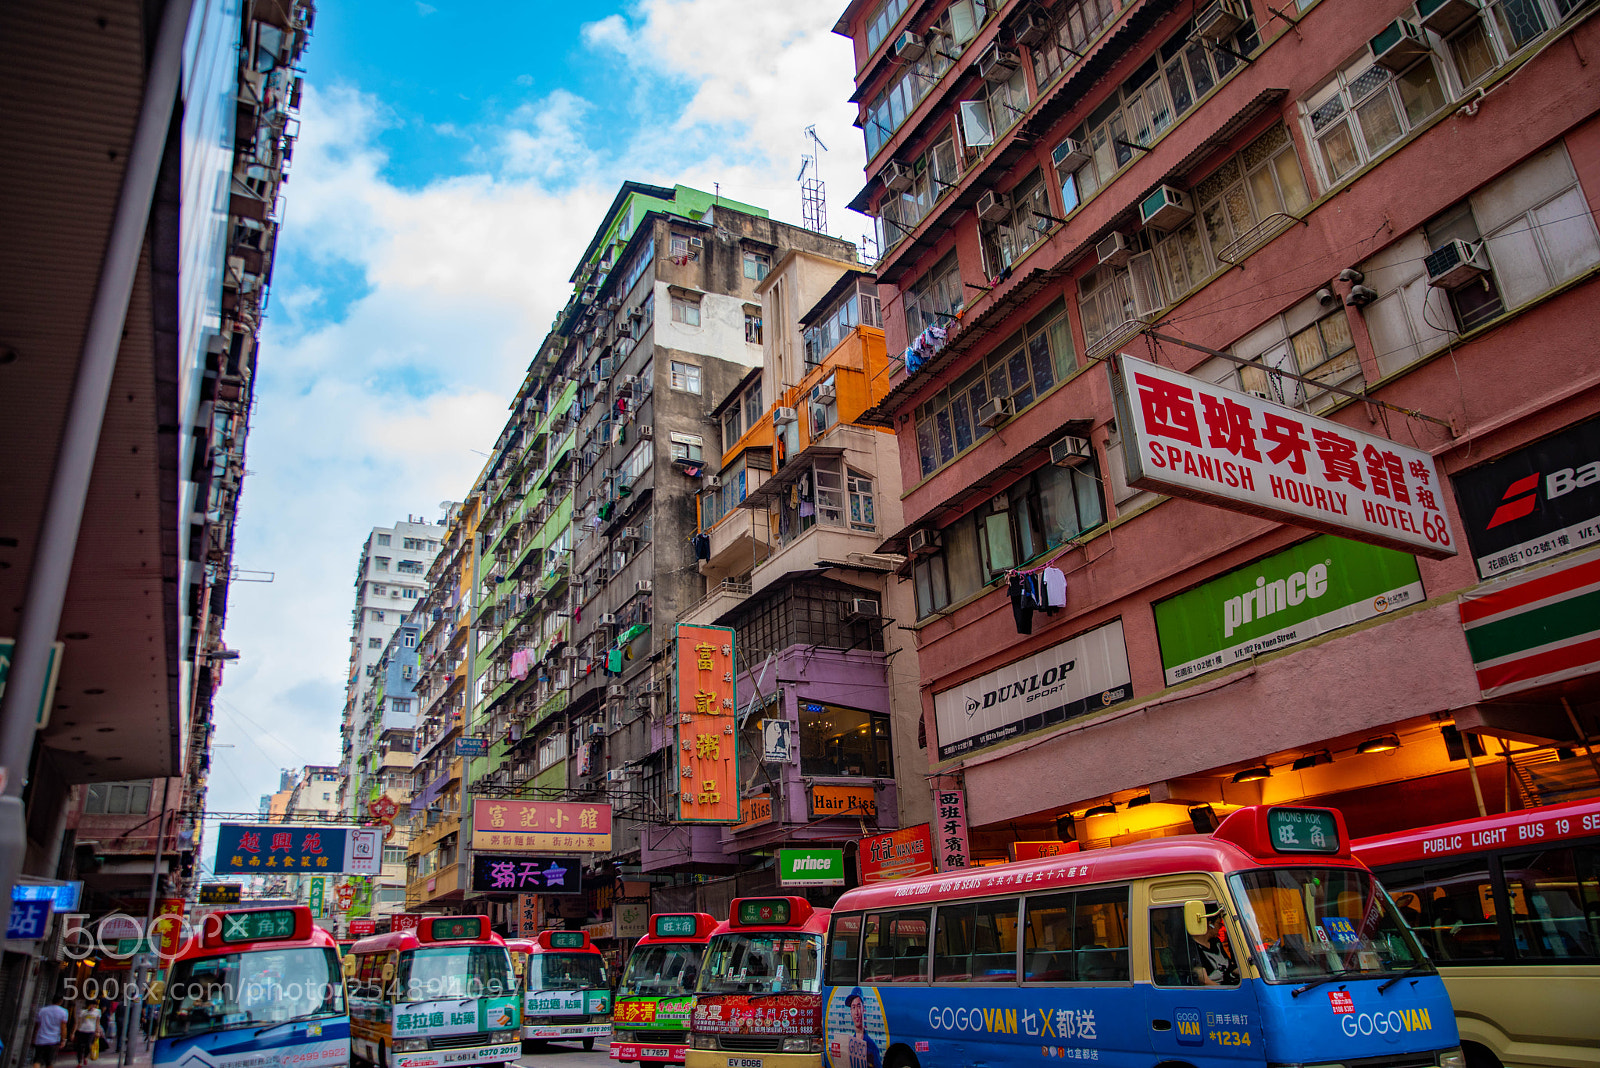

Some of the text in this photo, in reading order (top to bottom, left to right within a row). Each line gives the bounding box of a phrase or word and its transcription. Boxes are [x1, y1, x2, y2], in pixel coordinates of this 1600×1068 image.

[1134, 371, 1411, 506] 西班牙賓館
[1148, 440, 1450, 547] SPANISH HOURLY HOTEL 68
[1408, 459, 1439, 512] 時租
[1488, 534, 1569, 570] 花園街102號1樓
[1224, 563, 1328, 638] prince
[1174, 655, 1223, 678] 花園街102號1樓
[1262, 637, 1277, 649] Yuen
[1277, 630, 1297, 644] Street
[982, 660, 1076, 710] DUNLOP
[1026, 683, 1066, 703] SPORT
[694, 641, 721, 805] 富記粥品
[750, 803, 770, 821] Kiss
[814, 794, 875, 809] Hair Kiss
[488, 804, 599, 830] 富記小館
[939, 792, 966, 867] 西班牙賓館
[1277, 811, 1321, 825] MONG KOK
[237, 831, 324, 854] 越興苑
[490, 835, 596, 847] 粥粉麵飯 街坊小菜
[1278, 825, 1327, 847] 旺角
[1423, 814, 1600, 854] PUBLIC LIGHT BUS 19 SE
[870, 837, 925, 863] 允記 WAN KEE
[491, 861, 541, 889] 滿天
[792, 855, 831, 873] prince
[894, 865, 1089, 898] PUBLIC LIGHT BUS 16 SEATS 公共小型巴士十六座位
[396, 1011, 476, 1031] 慕拉適 貼藥
[929, 1006, 1097, 1040] GOGOVAN 乜X都送
[1176, 1012, 1199, 1021] GOGO
[1177, 1021, 1201, 1036] VAN
[1215, 1013, 1248, 1025] 用手機打
[1342, 1008, 1432, 1037] GOGOVAN
[292, 1052, 319, 1063] 2499
[321, 1047, 346, 1059] 9922
[479, 1046, 518, 1057] 6370 2010
[728, 1058, 761, 1067] EV 8066
